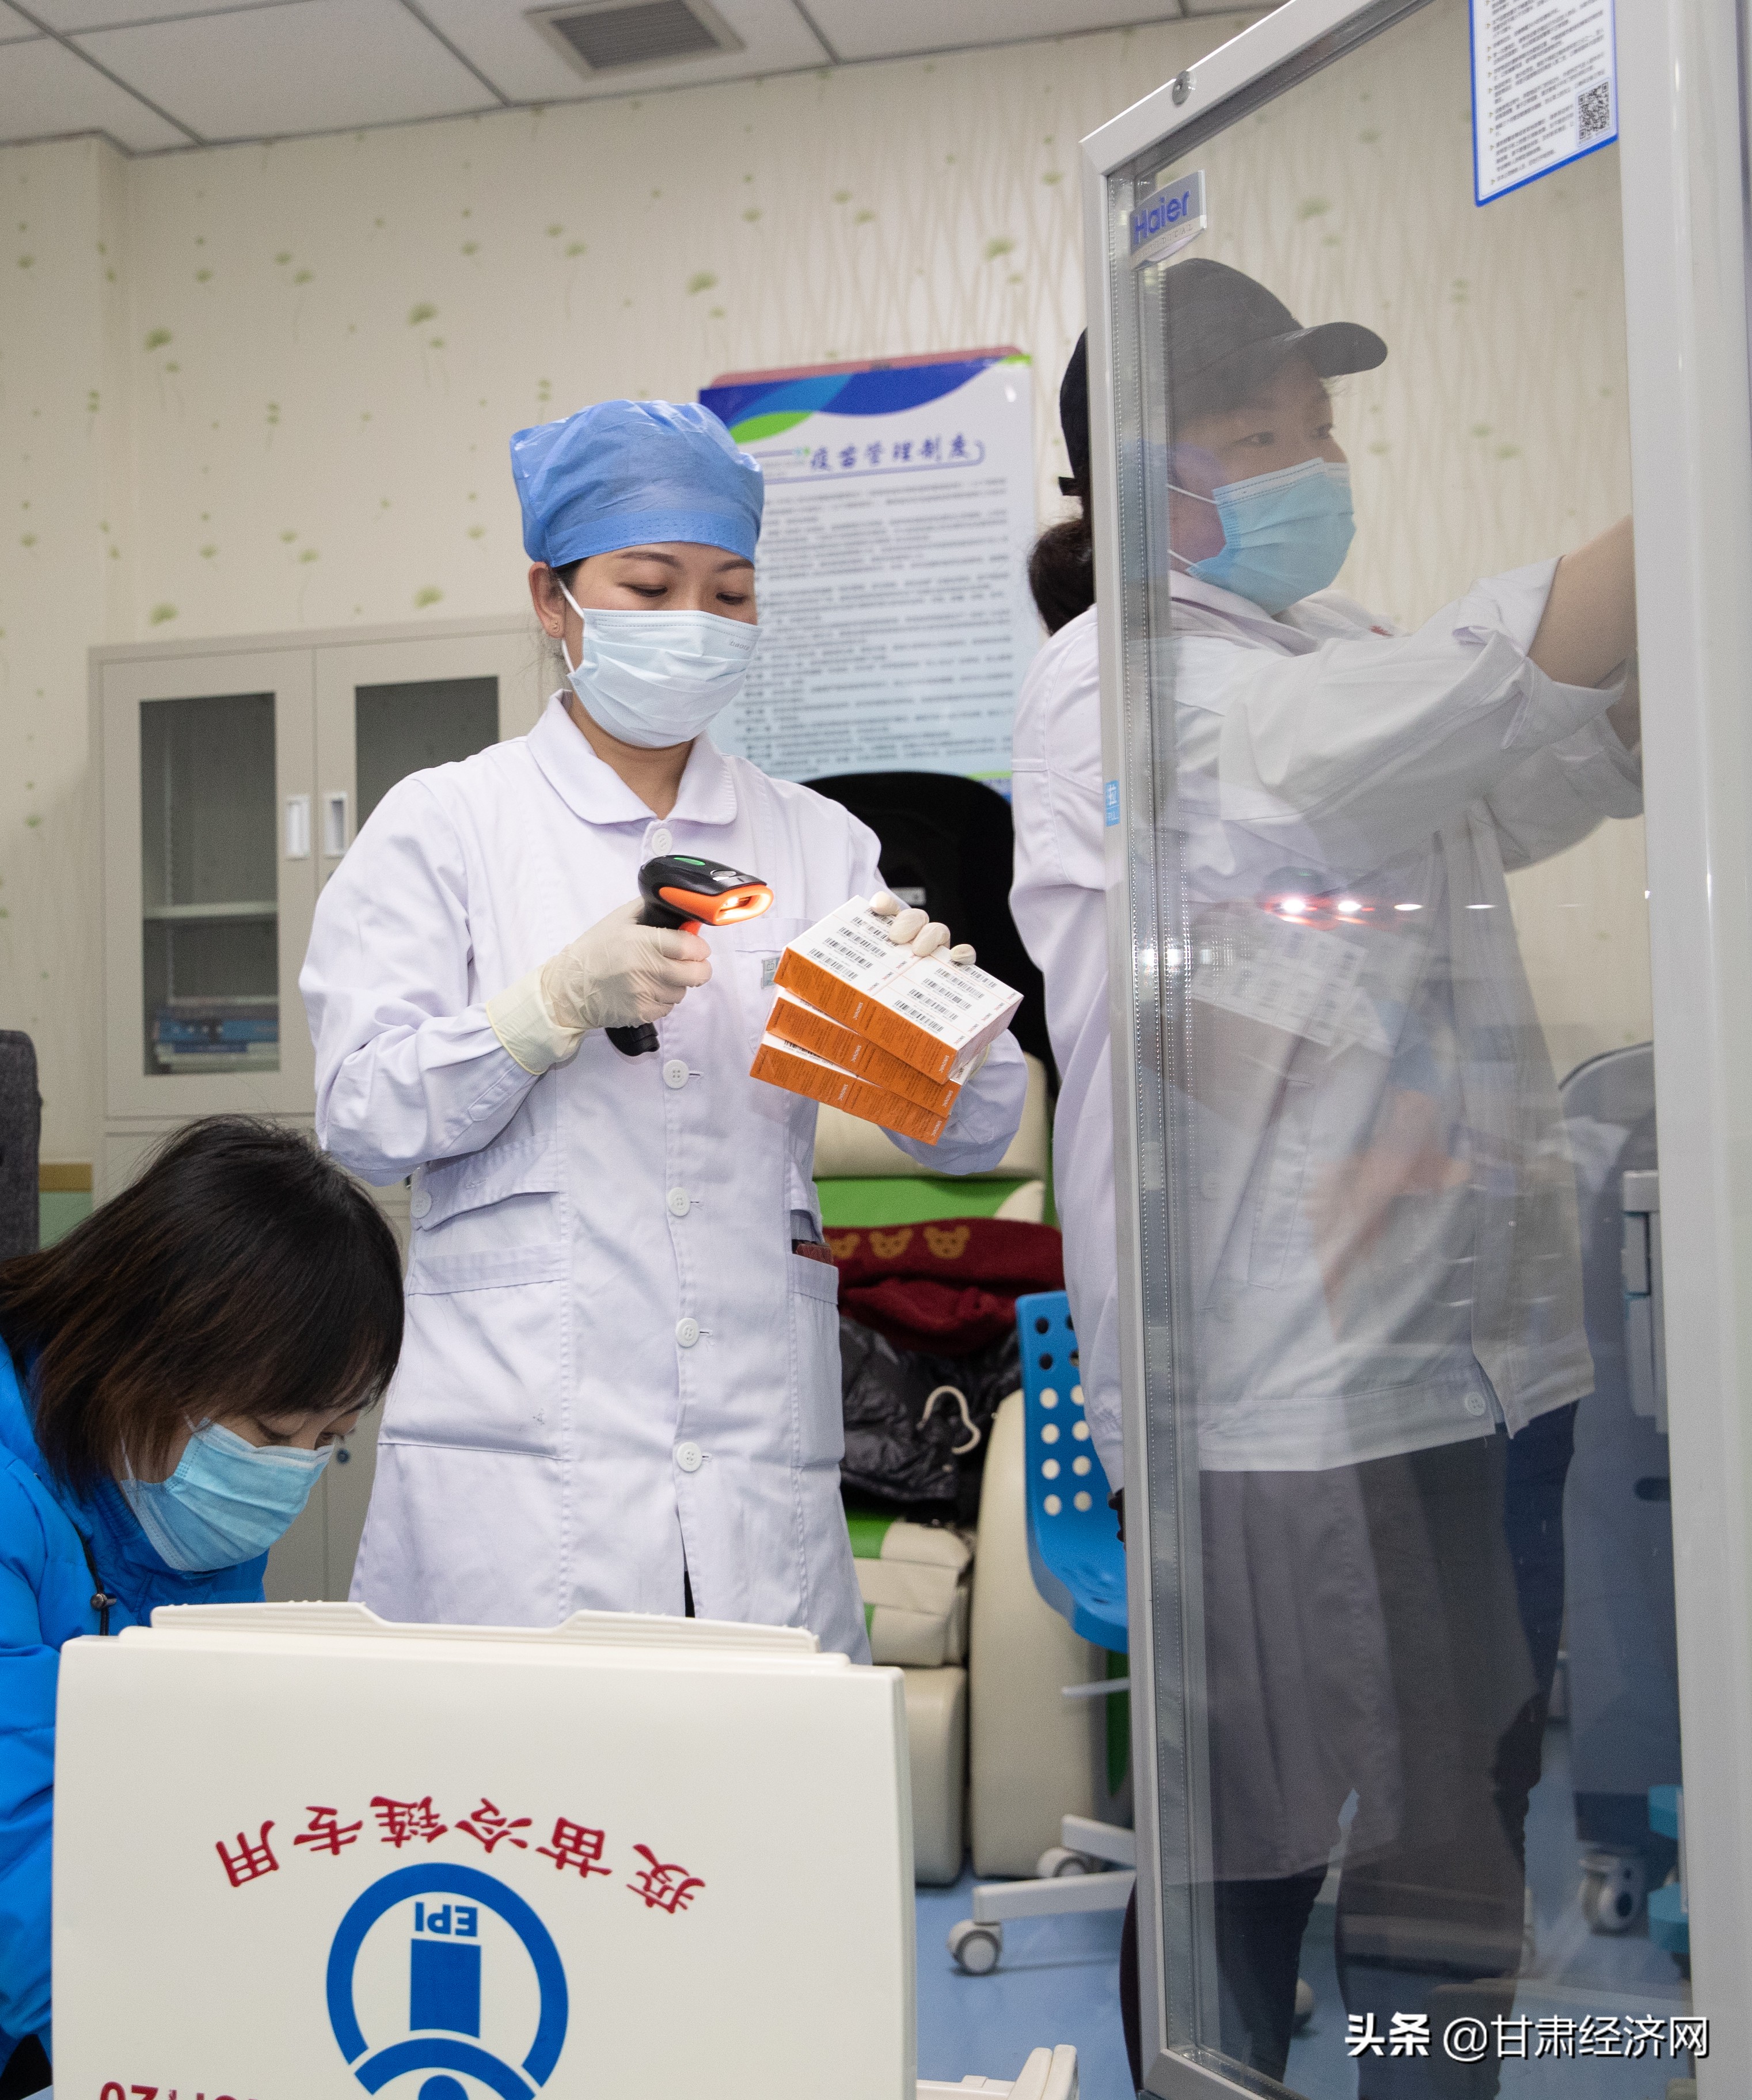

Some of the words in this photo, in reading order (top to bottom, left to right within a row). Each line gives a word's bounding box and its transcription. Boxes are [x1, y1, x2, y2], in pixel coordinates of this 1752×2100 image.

[1133, 191, 1189, 246] Haier
[215, 1795, 706, 1915] 疫苗冷链专用
[415, 1901, 478, 1938] EPI
